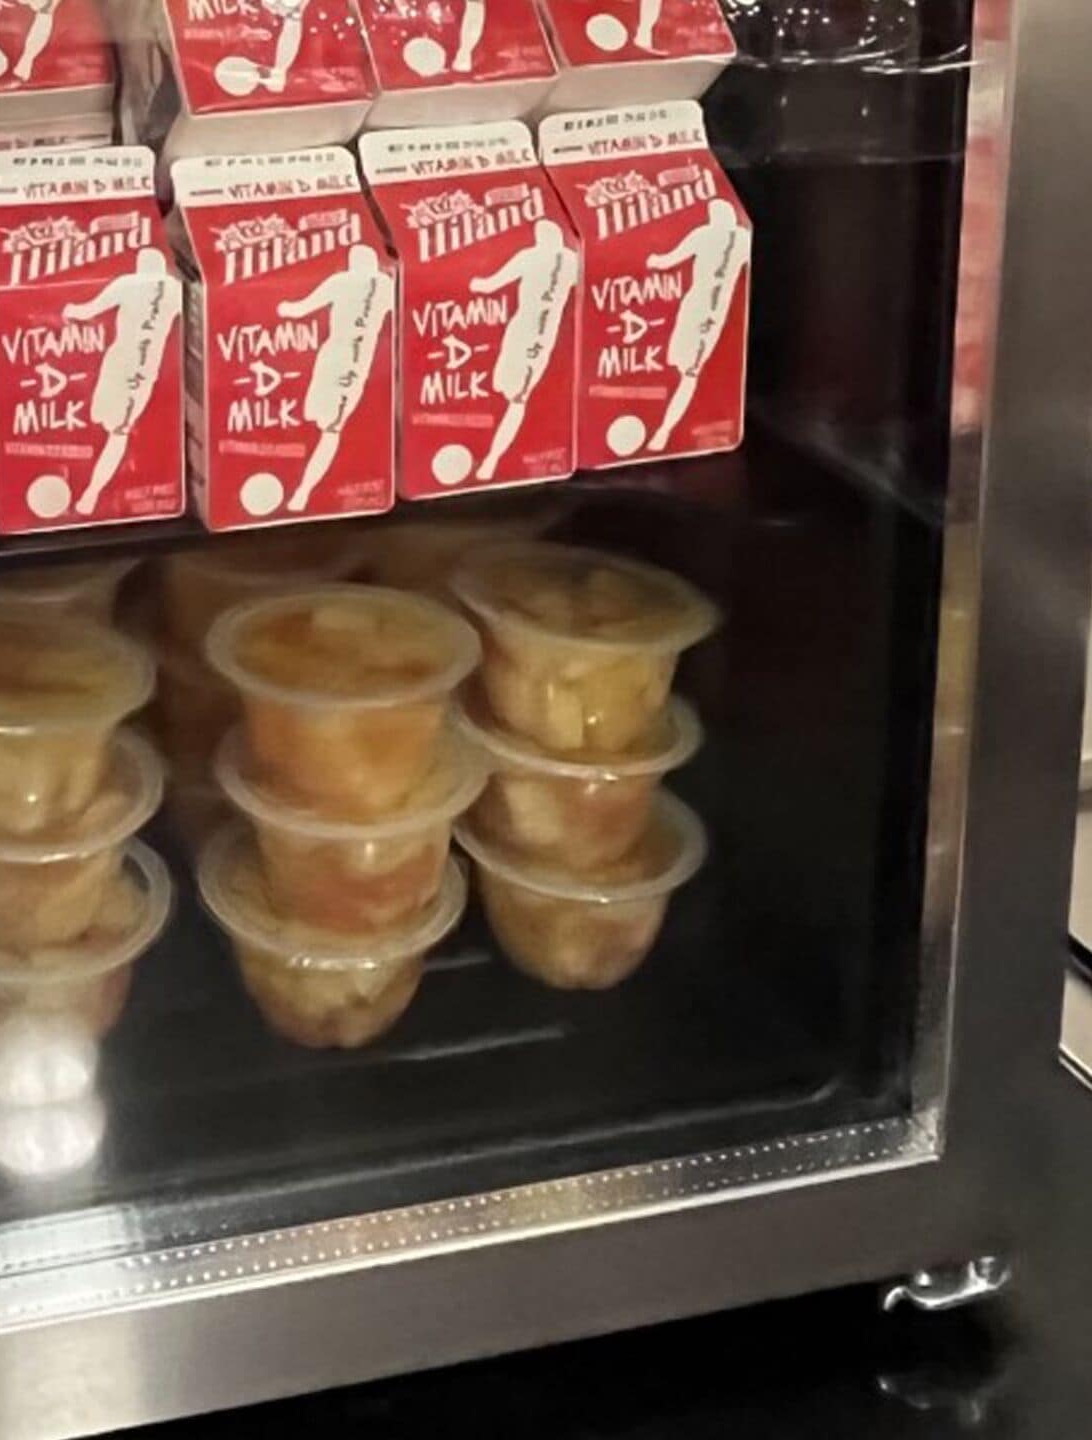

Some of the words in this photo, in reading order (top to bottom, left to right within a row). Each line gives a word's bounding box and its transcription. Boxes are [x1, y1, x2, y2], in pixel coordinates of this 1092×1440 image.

[591, 271, 682, 312] VITAMIN
[412, 294, 508, 338] VITAMIN
[2, 323, 105, 365] VITAMIN
[217, 319, 319, 363] VITAMIN
[597, 345, 664, 378] MILK
[420, 370, 490, 405] MILK
[13, 399, 87, 436] MILK
[227, 398, 301, 433] MILK
